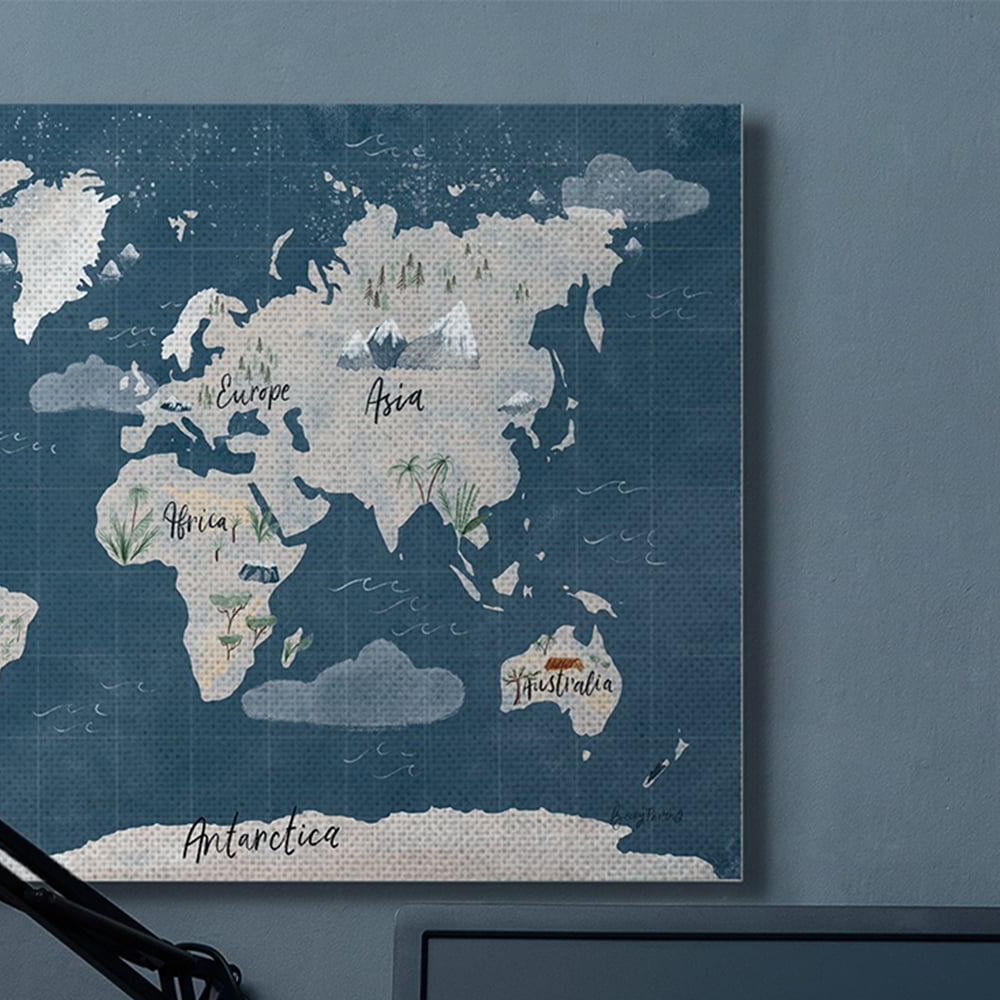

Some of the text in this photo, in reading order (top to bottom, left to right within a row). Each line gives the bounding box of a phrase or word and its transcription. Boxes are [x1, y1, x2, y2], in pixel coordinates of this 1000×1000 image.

[216, 373, 290, 410] Europe
[364, 376, 425, 424] Asia
[162, 501, 228, 540] Africa
[522, 669, 613, 701] Australia
[182, 805, 340, 864] Antarctica
